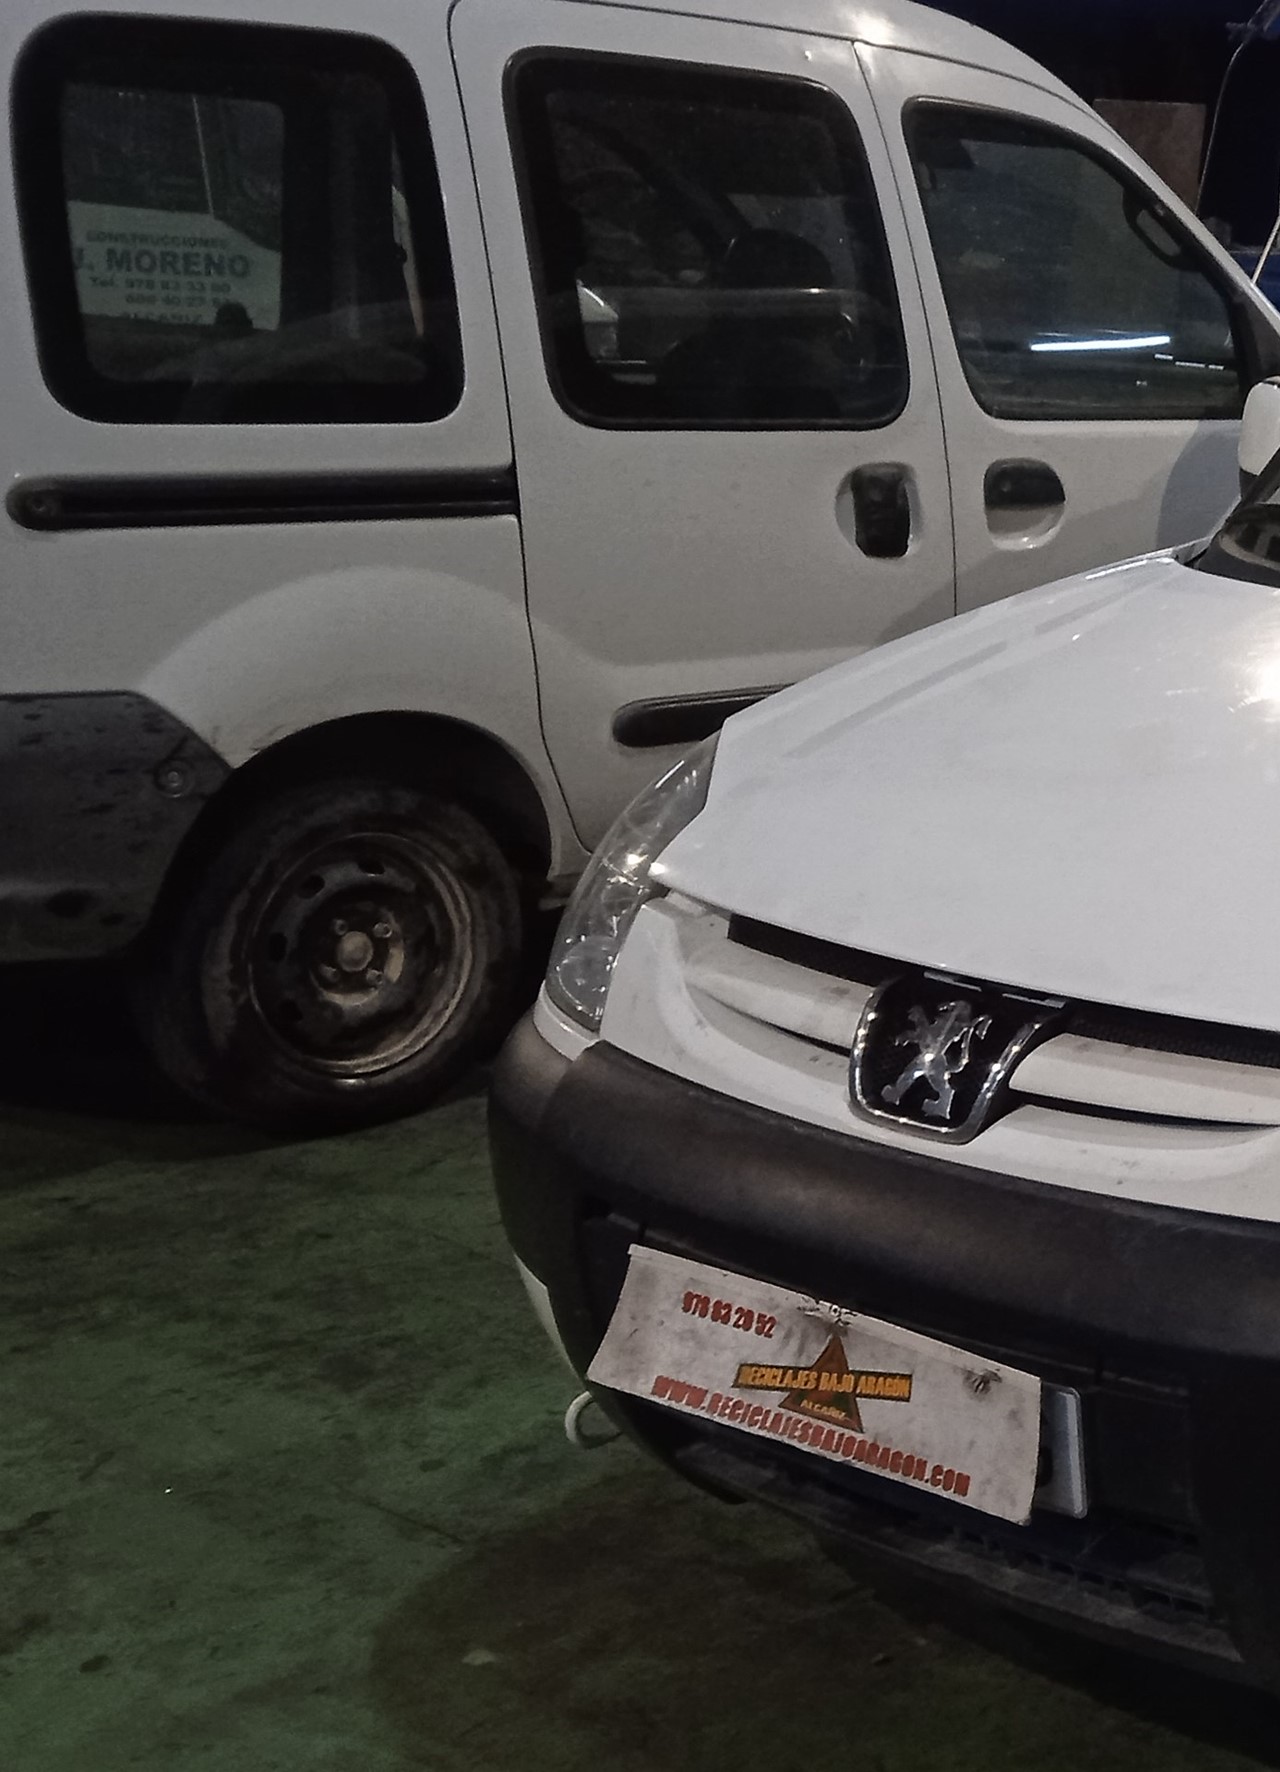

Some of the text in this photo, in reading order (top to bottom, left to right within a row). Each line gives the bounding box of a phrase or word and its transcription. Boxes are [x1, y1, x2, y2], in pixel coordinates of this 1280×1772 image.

[106, 247, 251, 278] MORENO
[732, 1306, 755, 1332] 20
[754, 1312, 777, 1339] 52
[819, 1372, 855, 1393] BAJO
